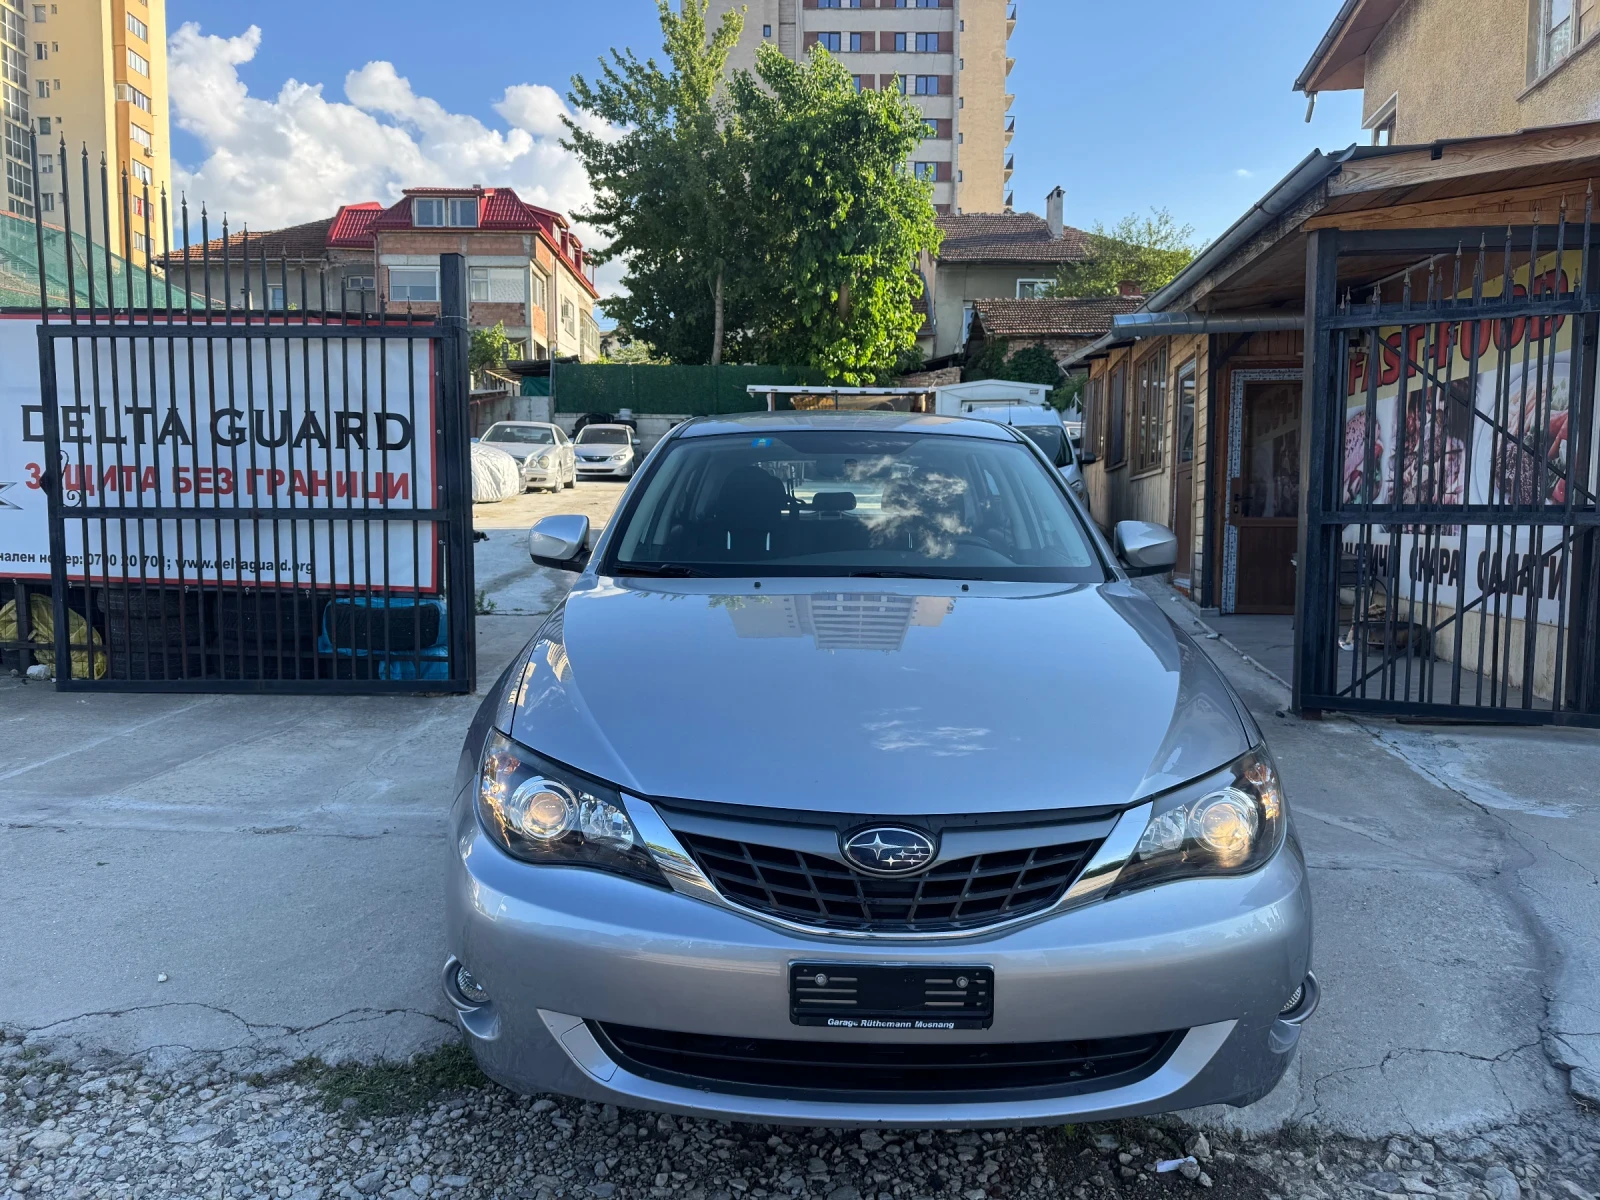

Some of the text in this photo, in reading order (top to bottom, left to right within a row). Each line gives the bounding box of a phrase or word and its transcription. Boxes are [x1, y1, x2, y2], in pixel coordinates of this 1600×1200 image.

[21, 405, 413, 450] DELTA GUARD
[25, 462, 409, 504] ЗЩИТА БЕЗ ГРАНИЦИ
[40, 554, 83, 567] нер:
[87, 553, 117, 566] 070
[175, 558, 314, 574] www.elaguad.rg
